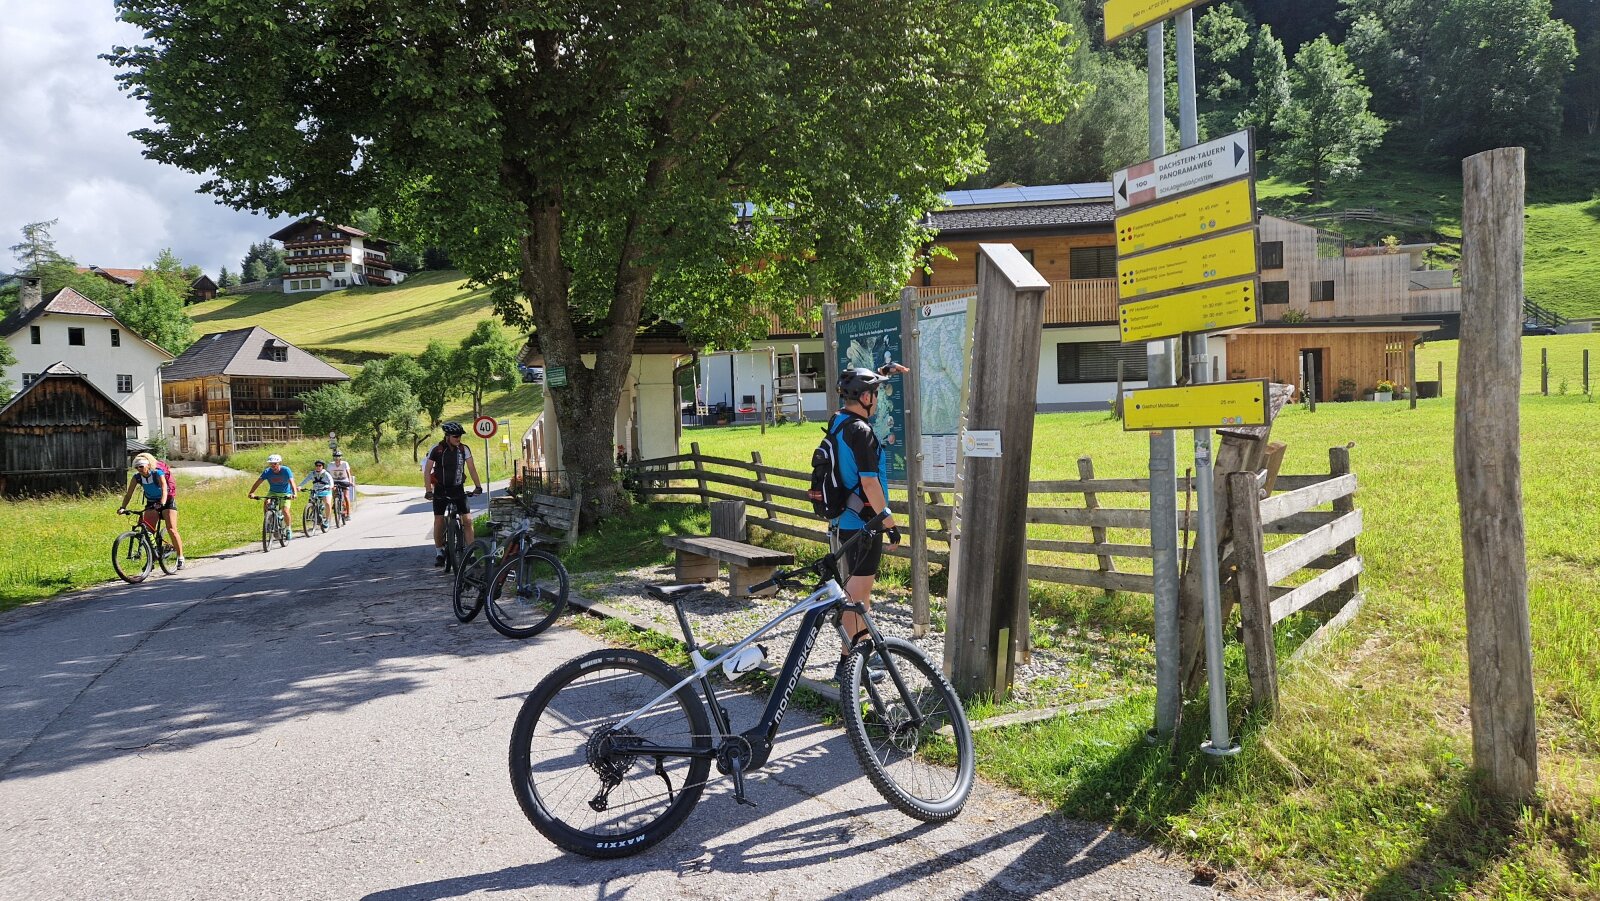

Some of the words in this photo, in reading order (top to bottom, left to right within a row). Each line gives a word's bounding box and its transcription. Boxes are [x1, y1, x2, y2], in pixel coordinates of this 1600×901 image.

[1158, 145, 1226, 172] DACHSTEIN-TAUERN
[1159, 159, 1213, 181] PANORAMAWEG
[1136, 180, 1148, 189] 100
[840, 321, 856, 334] Wilde
[858, 320, 882, 331] Wasser
[480, 422, 491, 432] 40
[774, 626, 818, 724] MONDRAKER
[596, 834, 646, 848] MAXXIS
